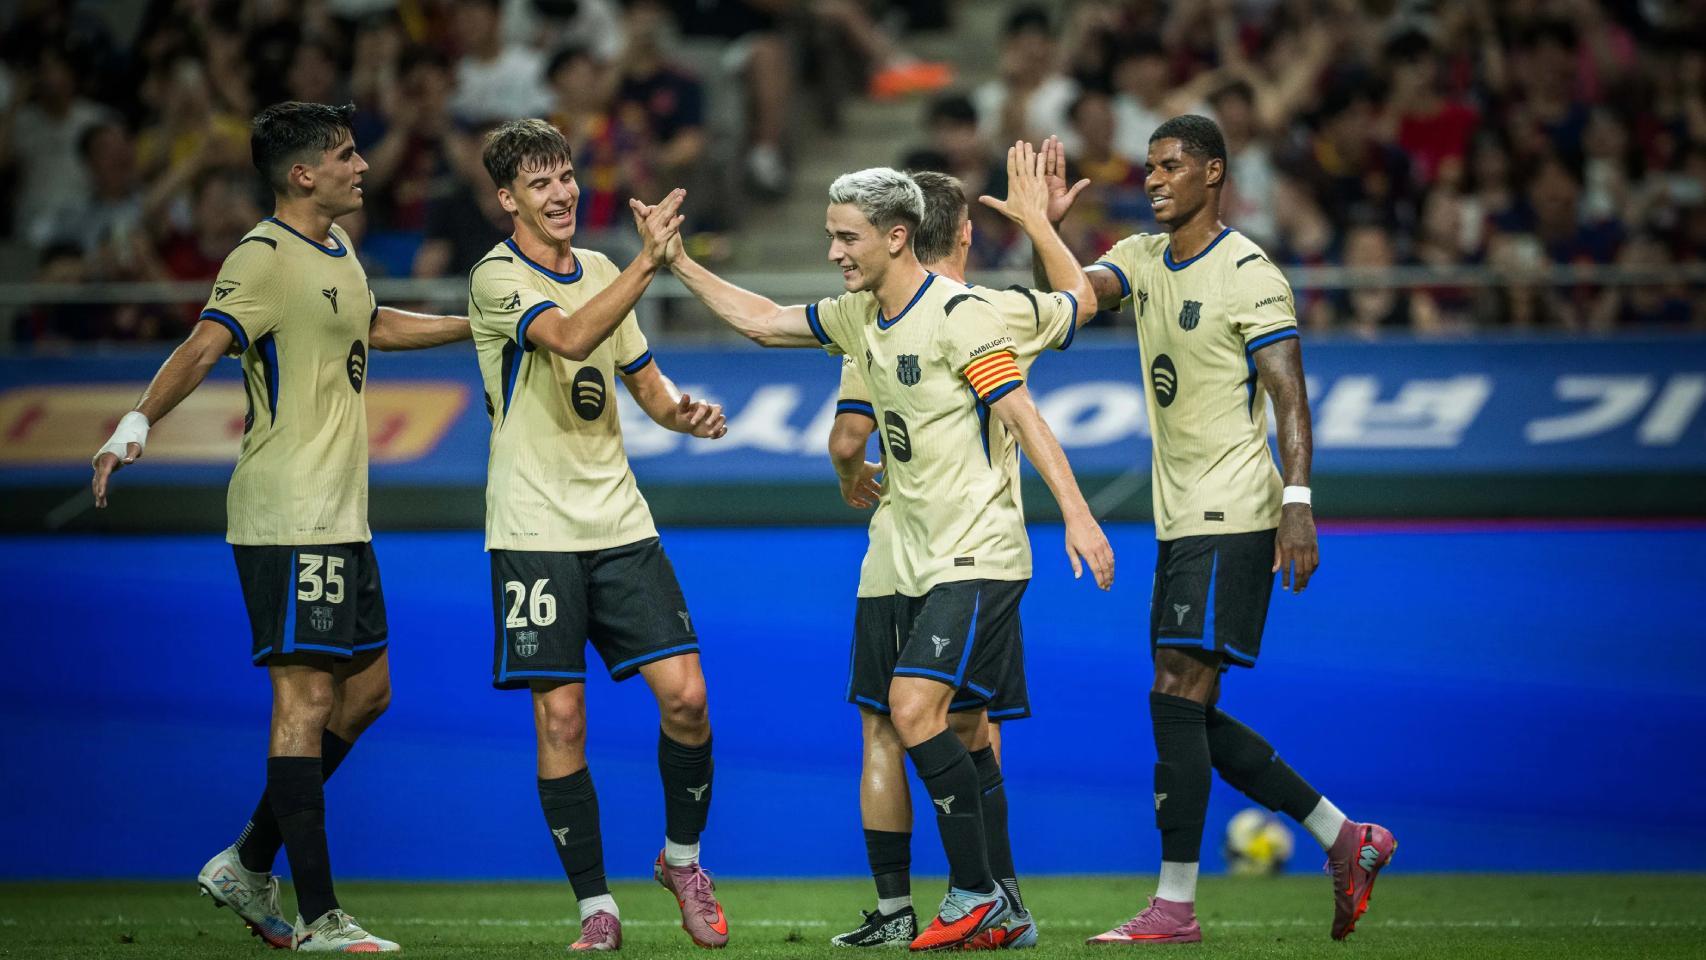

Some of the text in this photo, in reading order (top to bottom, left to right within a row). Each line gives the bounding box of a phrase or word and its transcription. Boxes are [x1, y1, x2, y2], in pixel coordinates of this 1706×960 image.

[969, 336, 1006, 358] AMBILIGHT
[298, 553, 345, 604] 35
[505, 578, 557, 629] 26
